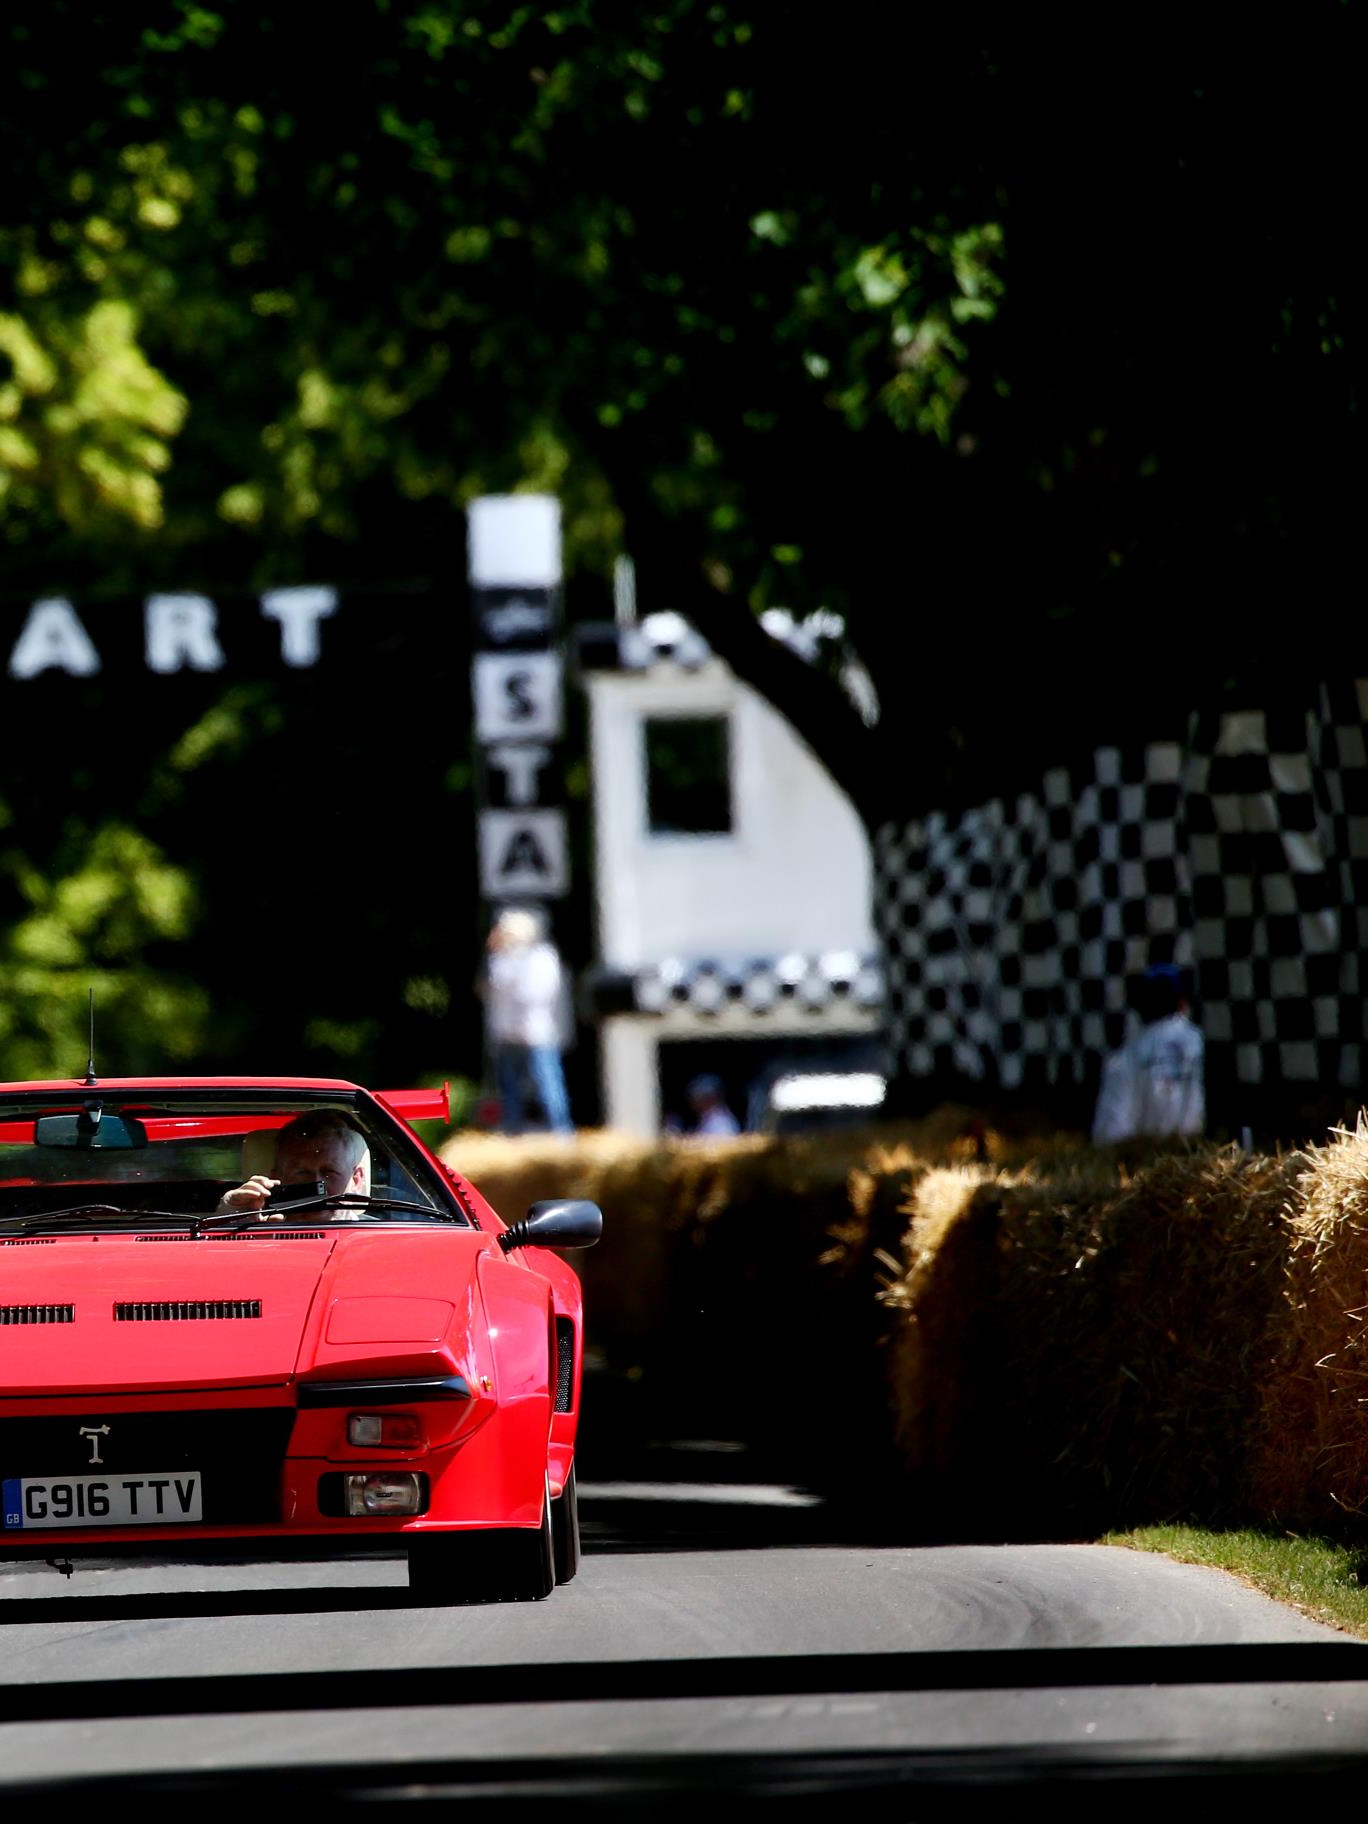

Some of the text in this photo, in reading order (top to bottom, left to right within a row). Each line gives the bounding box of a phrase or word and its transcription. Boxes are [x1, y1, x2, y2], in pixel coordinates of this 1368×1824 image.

[489, 669, 552, 880] STA
[6, 1513, 20, 1524] GB
[25, 1479, 195, 1520] G916 TTV
